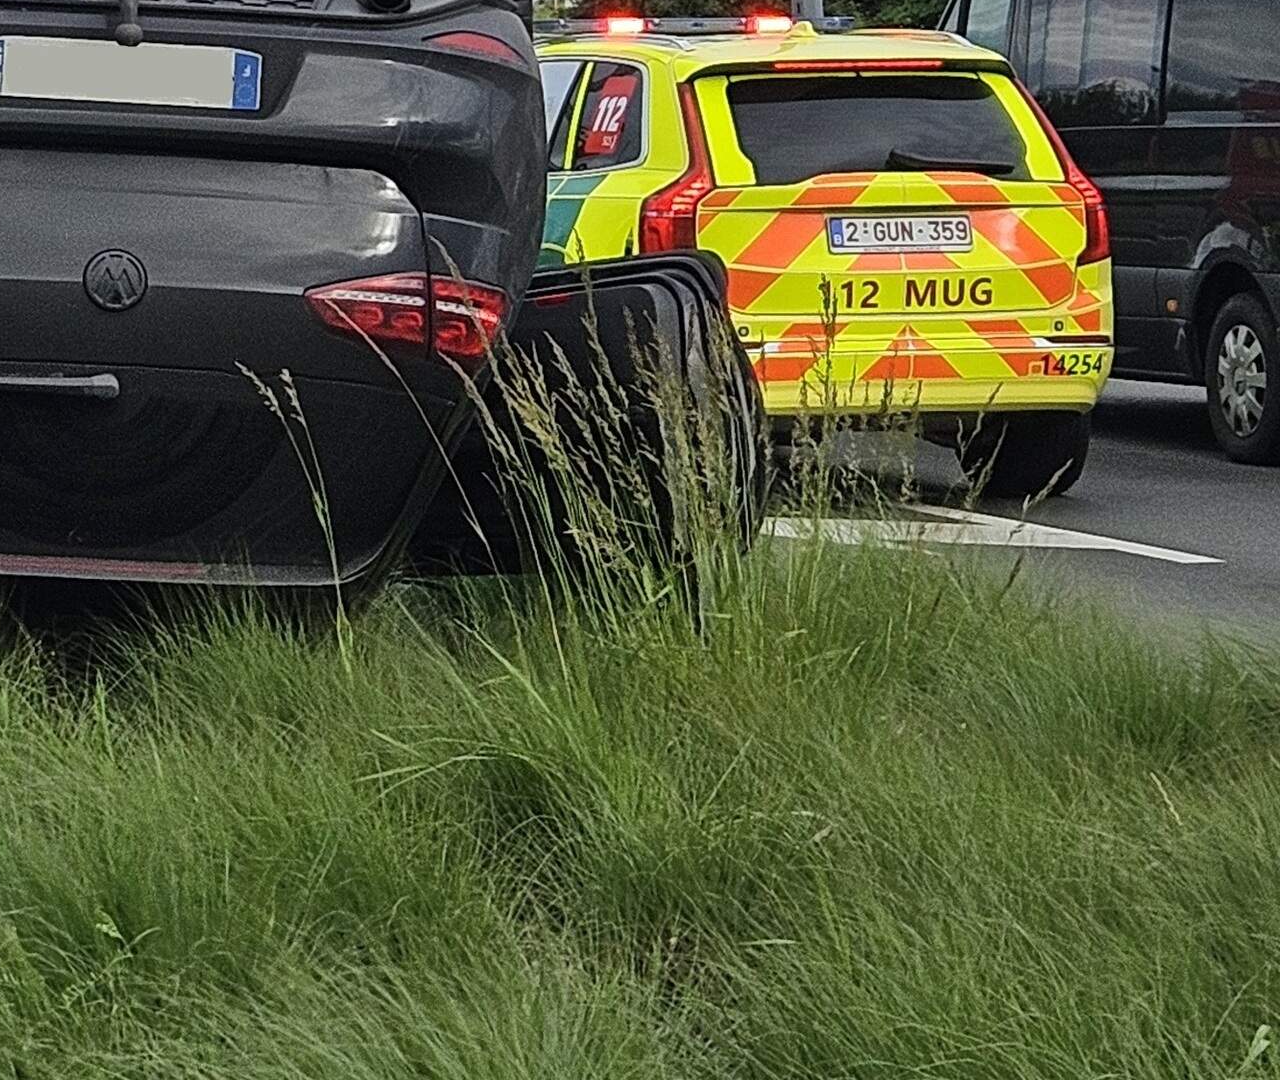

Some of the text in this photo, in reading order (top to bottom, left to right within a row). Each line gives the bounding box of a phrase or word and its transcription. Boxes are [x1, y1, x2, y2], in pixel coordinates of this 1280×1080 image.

[592, 96, 627, 132] 112
[904, 277, 993, 308] MUG
[1040, 352, 1103, 376] 14254
